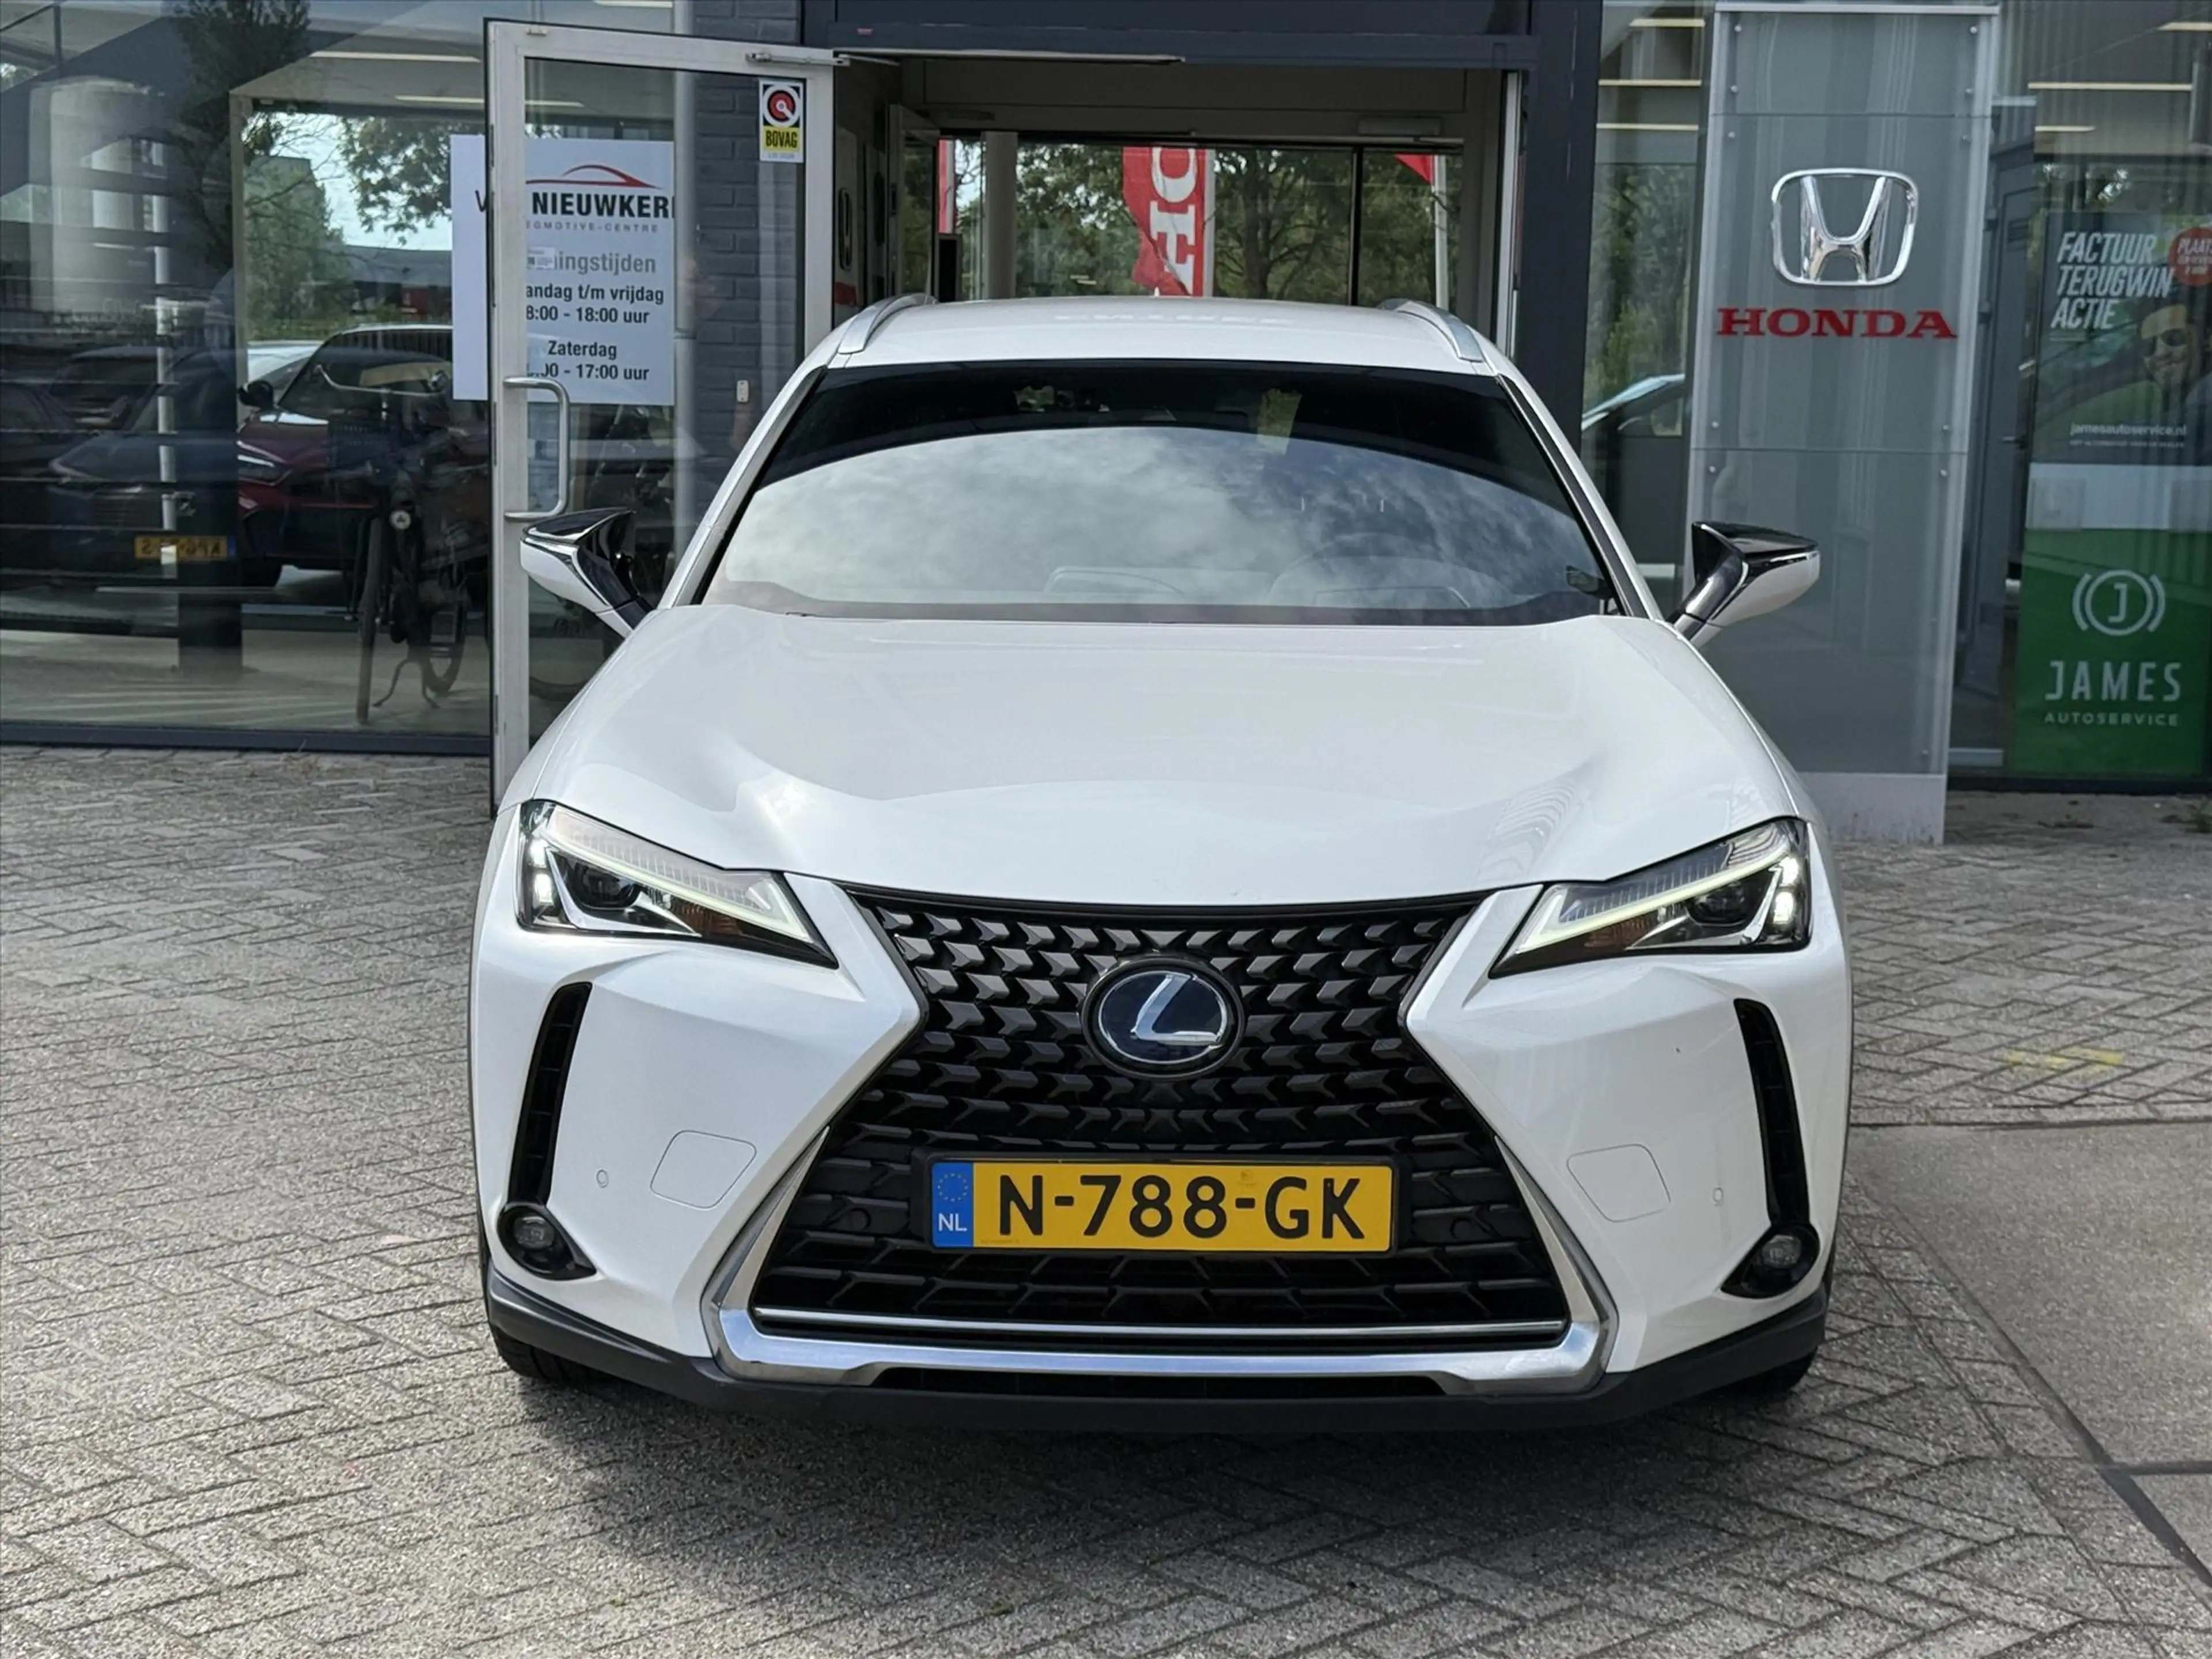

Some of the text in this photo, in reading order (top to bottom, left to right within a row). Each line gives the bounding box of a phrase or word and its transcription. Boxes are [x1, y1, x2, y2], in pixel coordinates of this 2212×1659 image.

[765, 130, 798, 149] BOVAG
[532, 192, 675, 219] NIEUWKER
[2056, 232, 2157, 264] FACTUUR
[554, 251, 656, 276] ingstijden
[527, 283, 664, 305] andag t/m vrijdag
[2056, 266, 2174, 298] TERUGWIN
[527, 305, 559, 321] 8:00
[576, 306, 619, 323] 18:00
[623, 311, 650, 324] uur
[1717, 308, 1957, 338] HONDA
[2050, 297, 2121, 329] ACTIE
[548, 340, 618, 360] Zaterdag
[576, 363, 619, 380] 17:00
[623, 368, 650, 381] uur
[2044, 660, 2181, 702] JAMES
[2044, 711, 2179, 727] AUTOSERVICE
[938, 1174, 1365, 1240] NL N-788-GK
